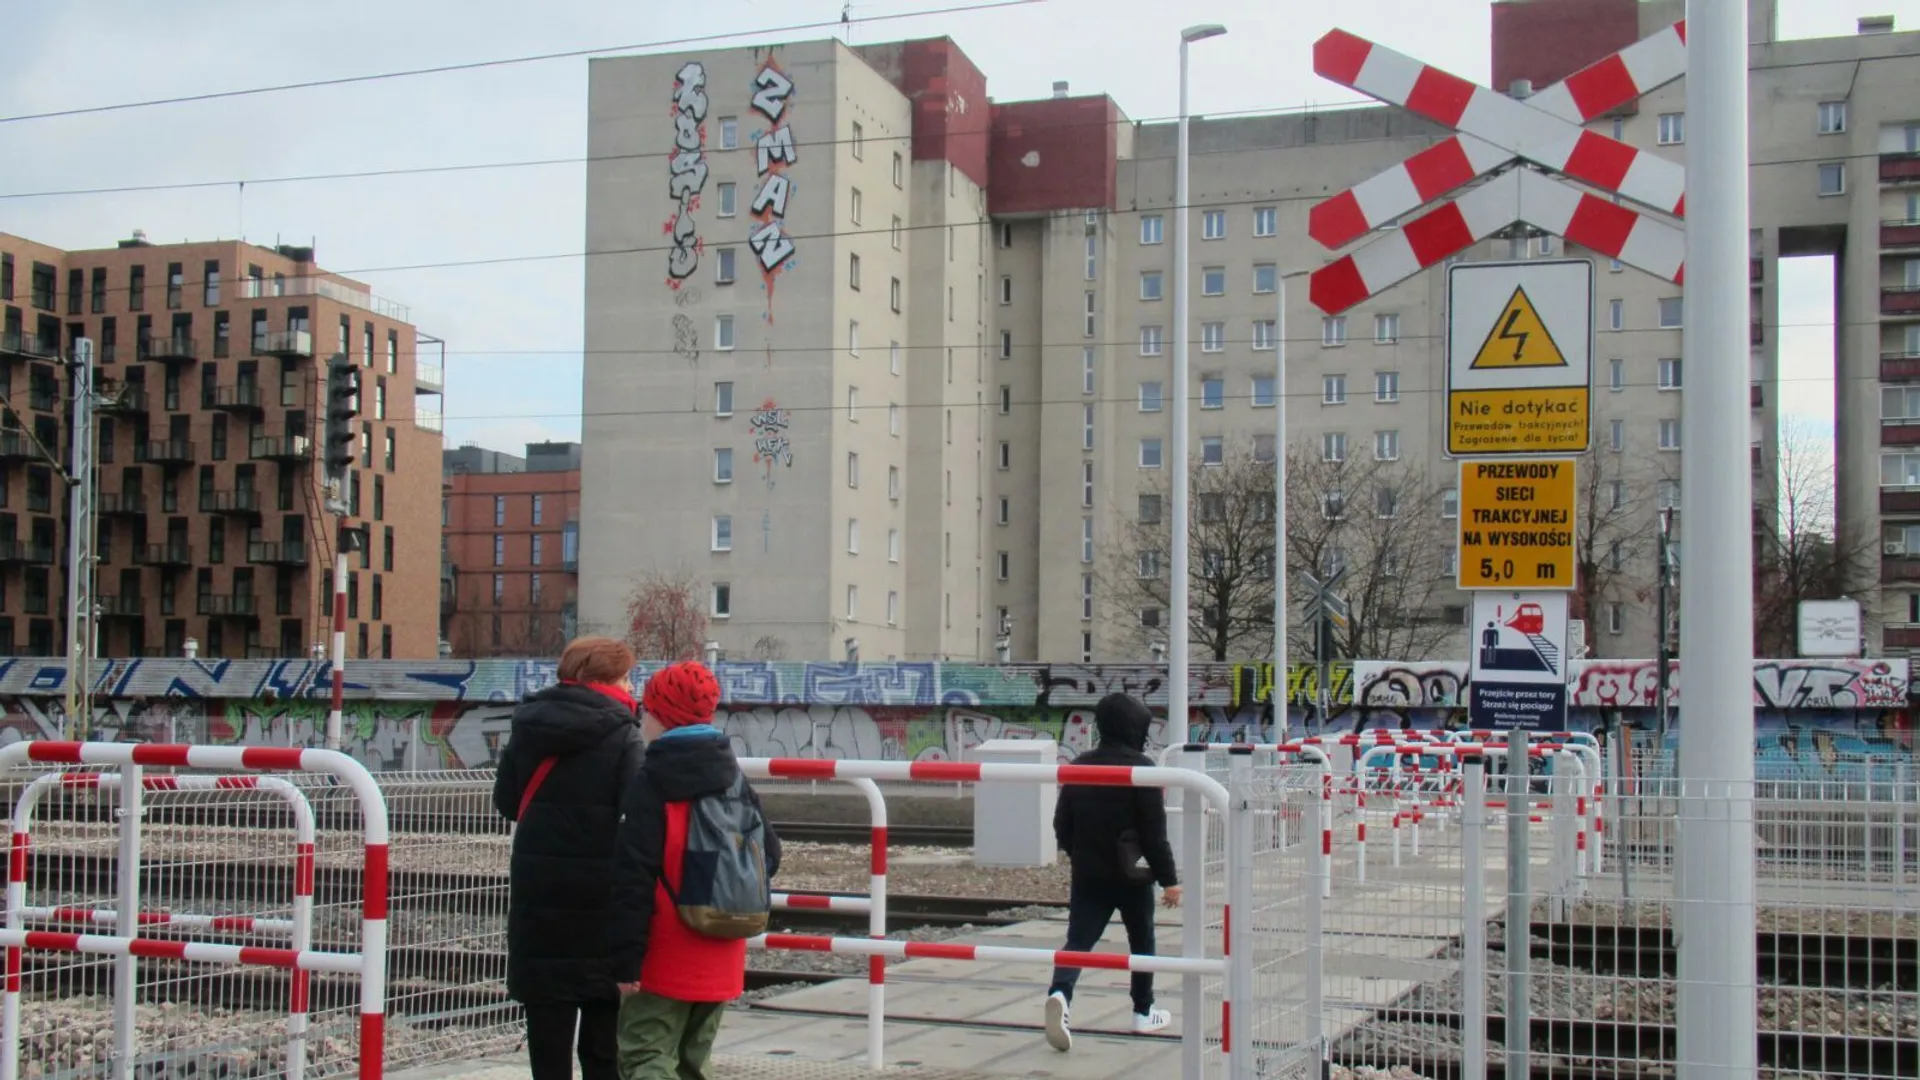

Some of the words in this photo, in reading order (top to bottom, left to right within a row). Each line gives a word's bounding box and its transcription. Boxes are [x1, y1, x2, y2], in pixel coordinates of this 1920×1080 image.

[1460, 401, 1491, 415] Nie
[1502, 398, 1578, 418] dotykać
[1523, 434, 1541, 442] dla
[1477, 464, 1559, 478] PRZEWODY
[1496, 487, 1534, 501] SIECI
[1473, 509, 1568, 523] TRAKCYJNEJ
[1463, 532, 1481, 545] NA
[1488, 528, 1572, 546] WYSOKOŚCI
[1480, 559, 1514, 582] 5,0
[1536, 562, 1555, 578] m
[1479, 689, 1514, 698] Przejście
[1515, 691, 1537, 699] przez
[1539, 691, 1556, 700] tory
[1508, 701, 1519, 710] się
[1520, 702, 1553, 711] pociągu
